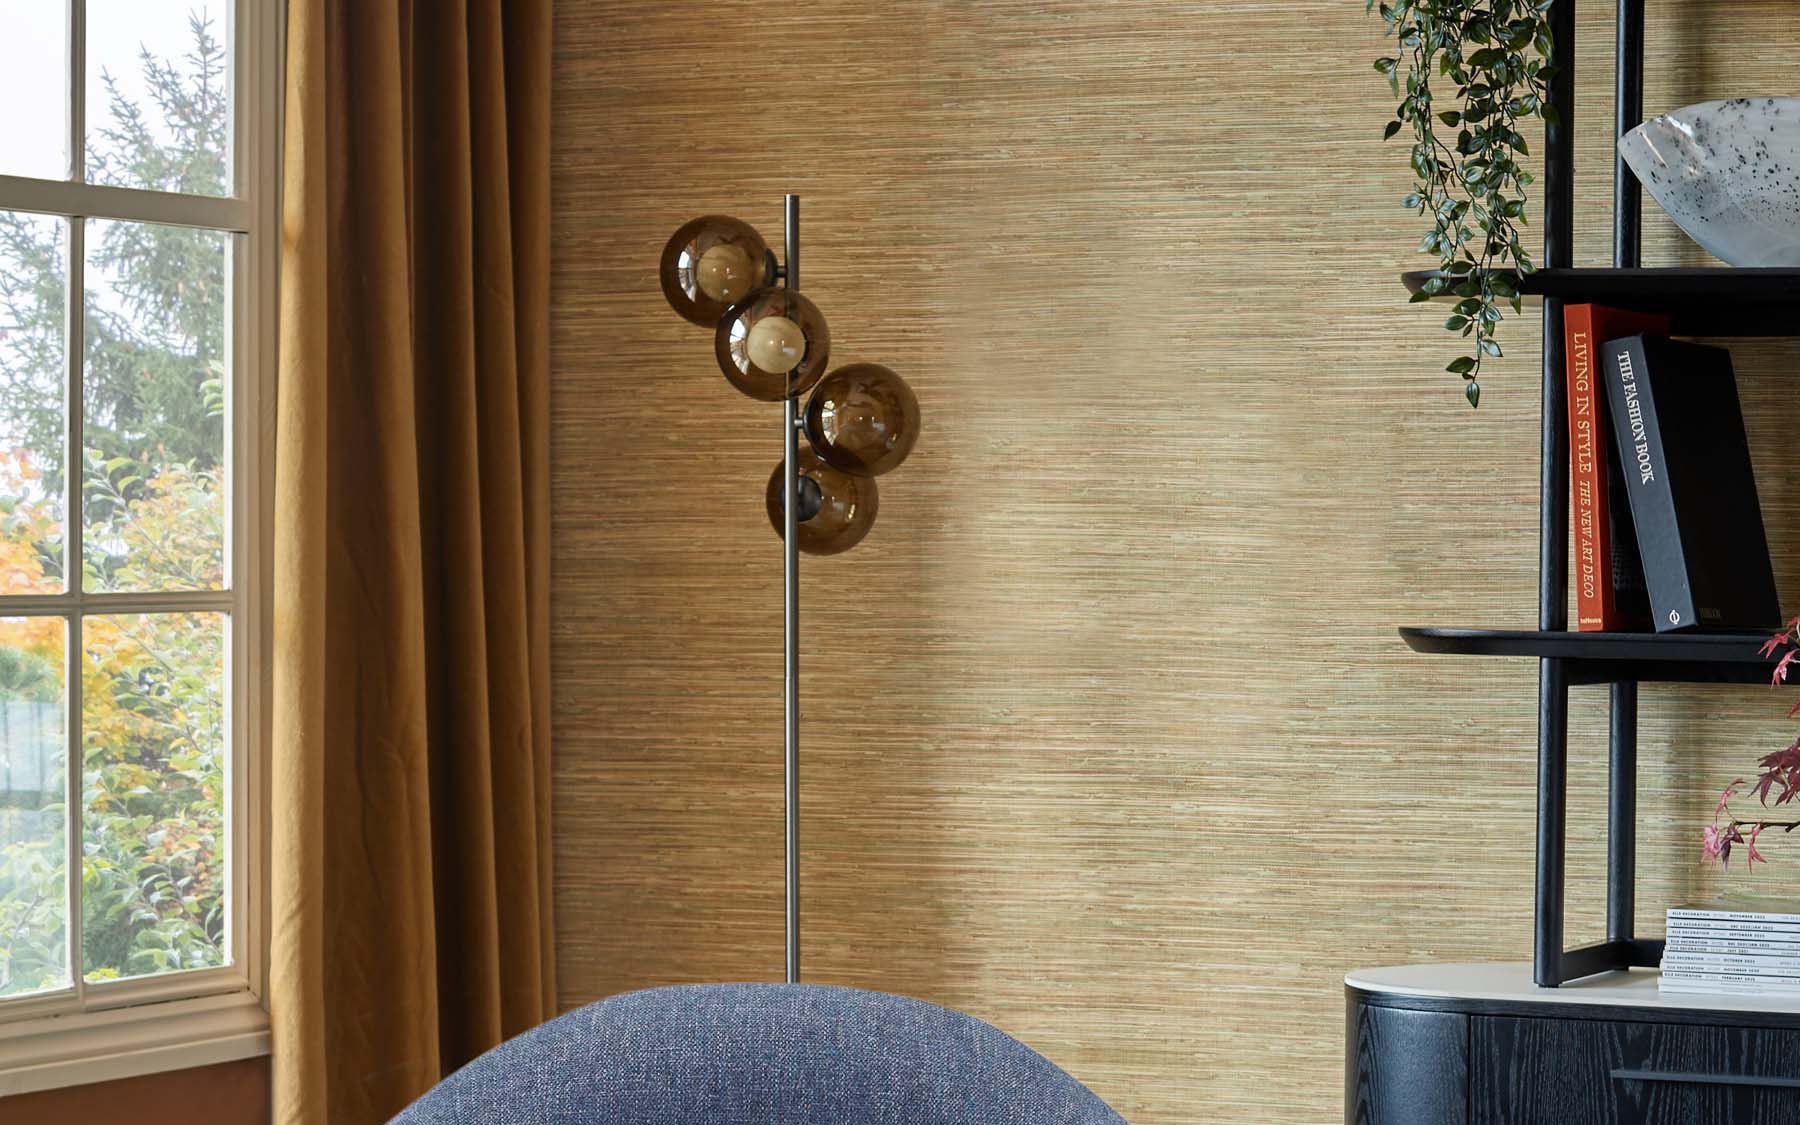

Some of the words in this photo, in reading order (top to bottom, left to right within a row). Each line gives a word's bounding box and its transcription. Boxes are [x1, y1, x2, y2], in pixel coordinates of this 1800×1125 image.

[1573, 332, 1588, 392] LIVING
[1617, 350, 1634, 382] THE
[1576, 396, 1589, 416] IN
[1624, 382, 1647, 441] FASHION
[1577, 420, 1591, 473] STYLE
[1635, 442, 1655, 485] BOOK
[1579, 480, 1591, 507] THE
[1580, 509, 1592, 539] NEW
[1582, 539, 1593, 564] ART
[1583, 563, 1595, 598] DECO
